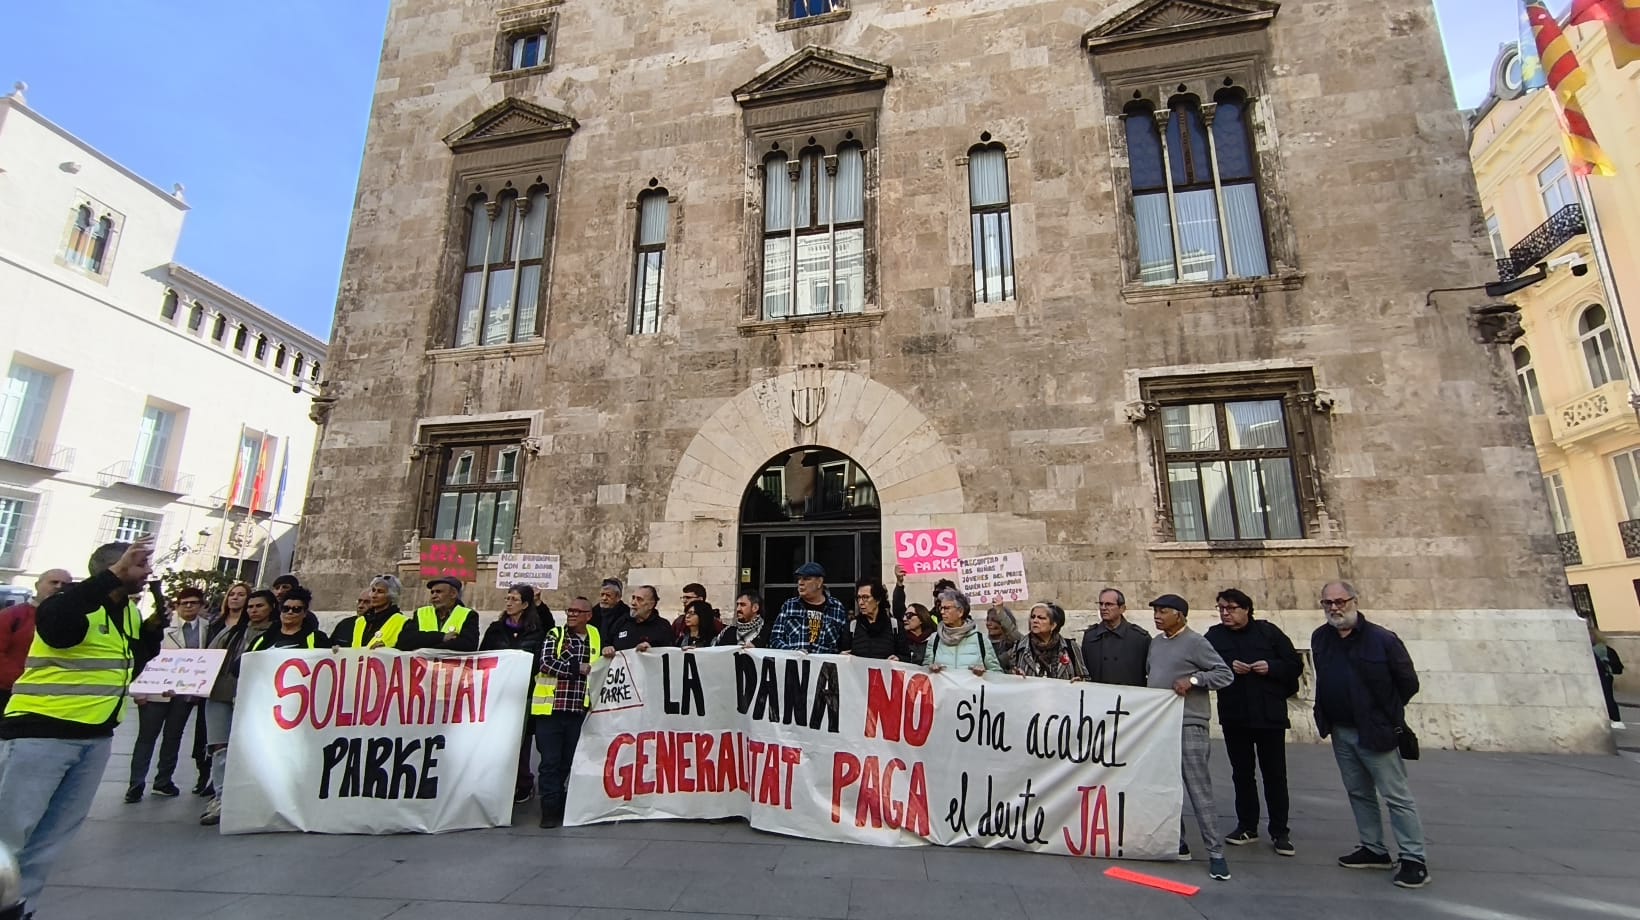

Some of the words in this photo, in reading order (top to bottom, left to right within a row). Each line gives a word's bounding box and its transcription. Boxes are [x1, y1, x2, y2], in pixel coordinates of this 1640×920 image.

[913, 558, 958, 573] PARKE
[600, 685, 631, 704] PARKE
[606, 667, 626, 685] SOS
[662, 652, 705, 716] LA
[733, 651, 840, 733] DANA
[864, 667, 934, 747] NO
[1026, 690, 1130, 767] acabat
[319, 734, 446, 799] PARKE
[603, 730, 803, 810] GENERALITAT
[831, 751, 930, 836] PAGA
[945, 772, 971, 836] el
[978, 775, 1048, 844] deute
